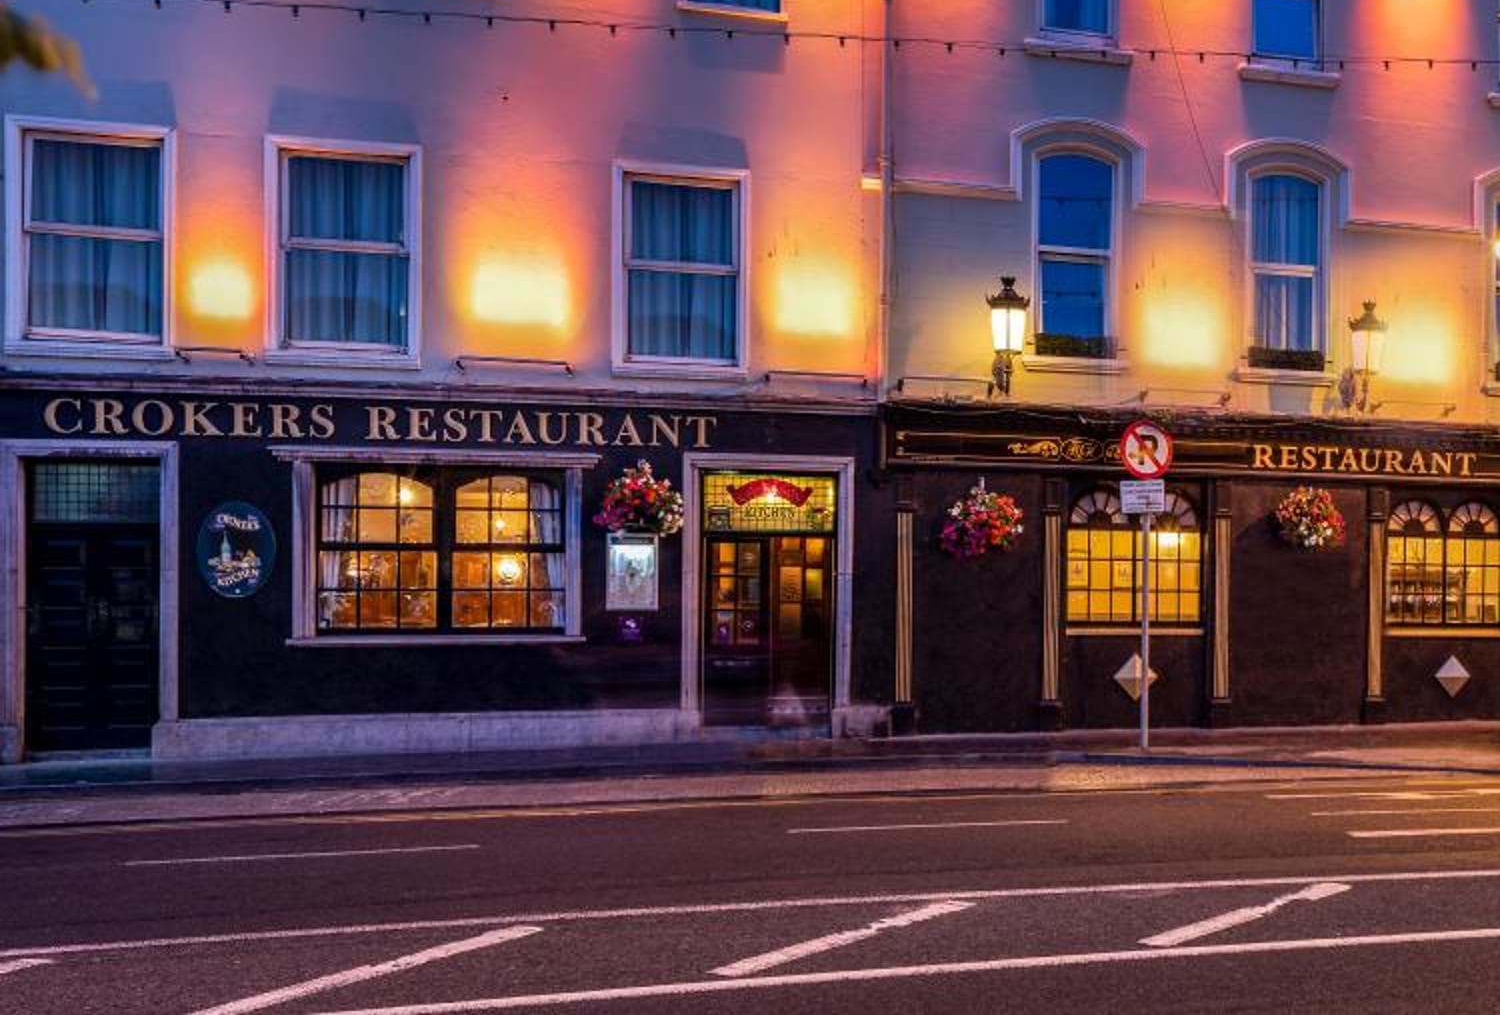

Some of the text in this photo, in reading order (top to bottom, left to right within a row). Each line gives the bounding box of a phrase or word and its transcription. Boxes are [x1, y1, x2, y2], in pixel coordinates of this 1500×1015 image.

[43, 397, 718, 448] CROKERS RESTAURANT
[1251, 443, 1477, 476] RESTAURANT
